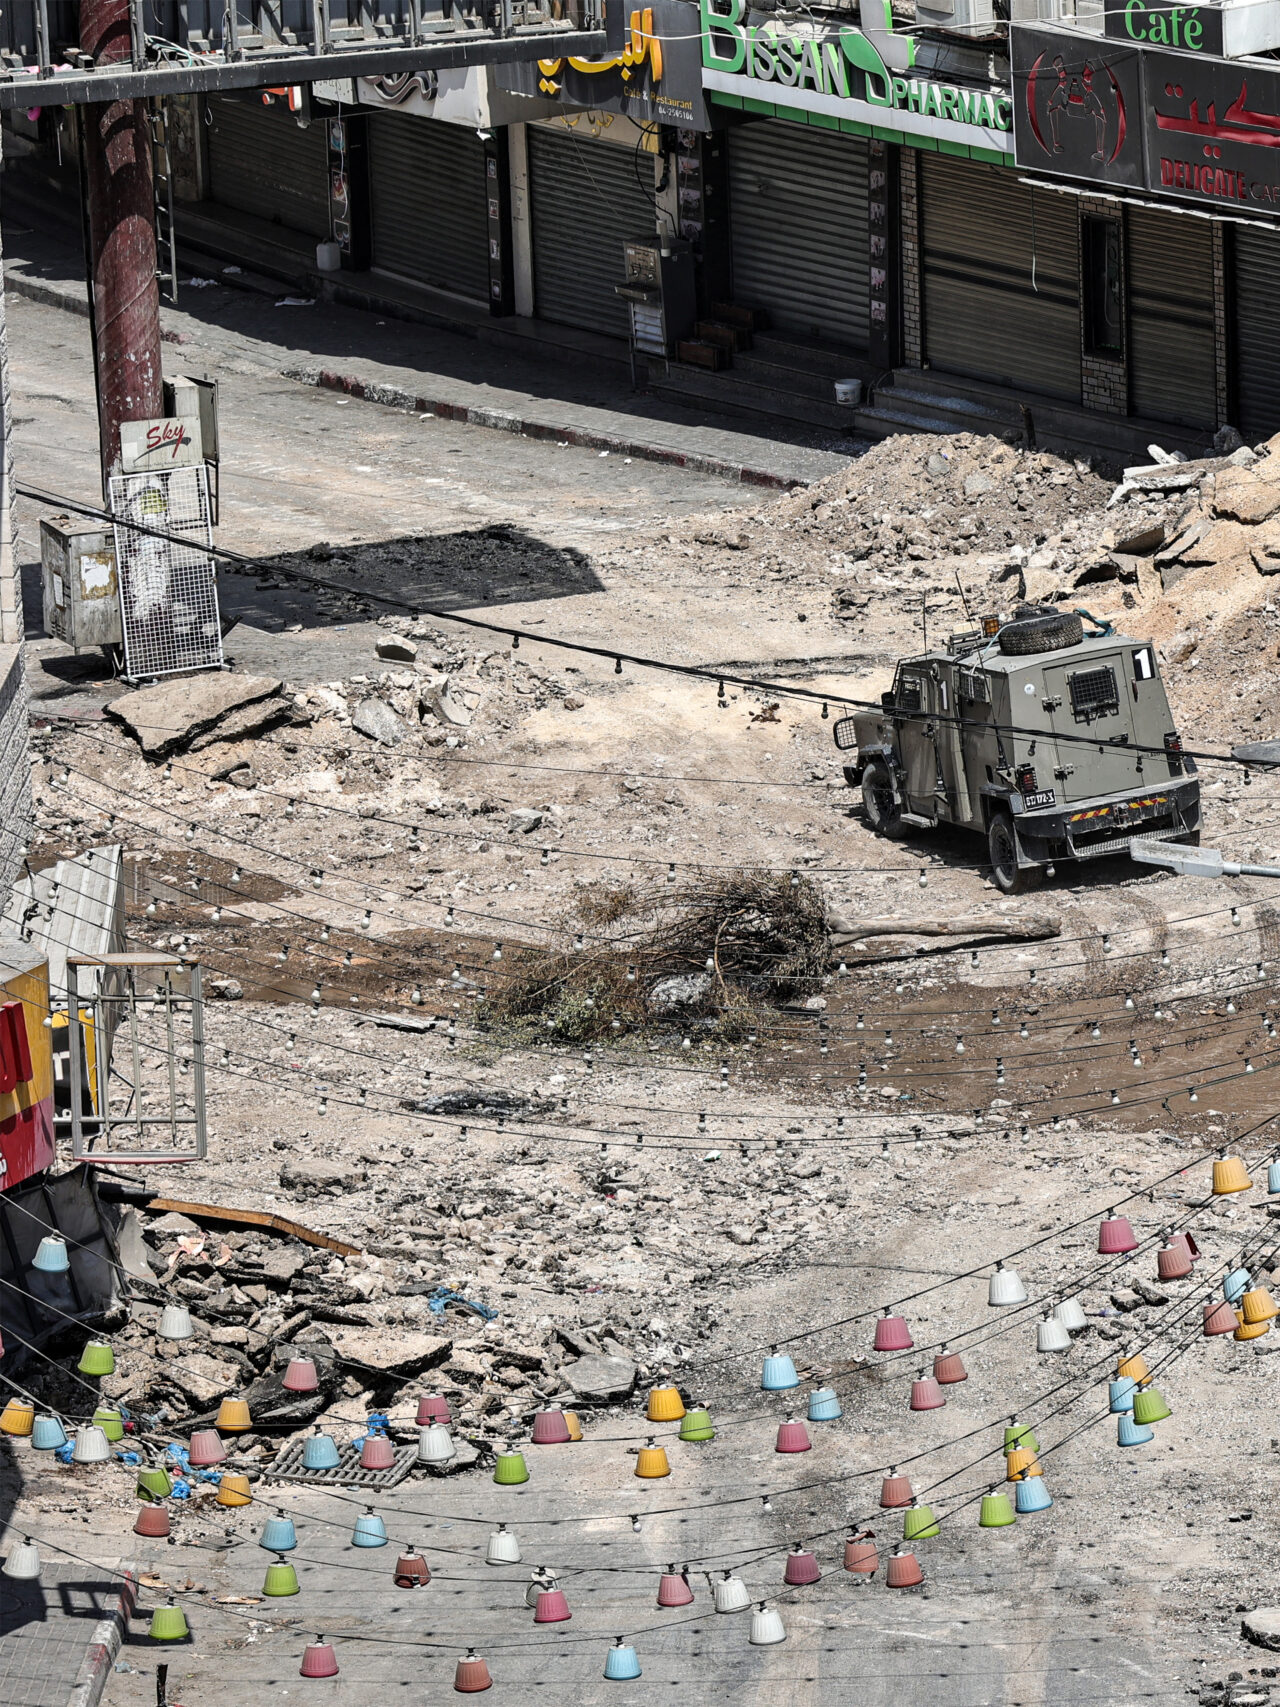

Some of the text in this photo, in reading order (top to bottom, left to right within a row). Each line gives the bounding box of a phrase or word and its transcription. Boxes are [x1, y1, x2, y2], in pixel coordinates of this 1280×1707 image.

[1125, 0, 1203, 49] Café
[701, 0, 850, 97] BISSAN
[650, 91, 693, 110] Restaurant
[1160, 157, 1248, 200] DELICATE
[146, 421, 186, 459] Sky
[1134, 648, 1152, 680] 1
[940, 680, 949, 711] 1
